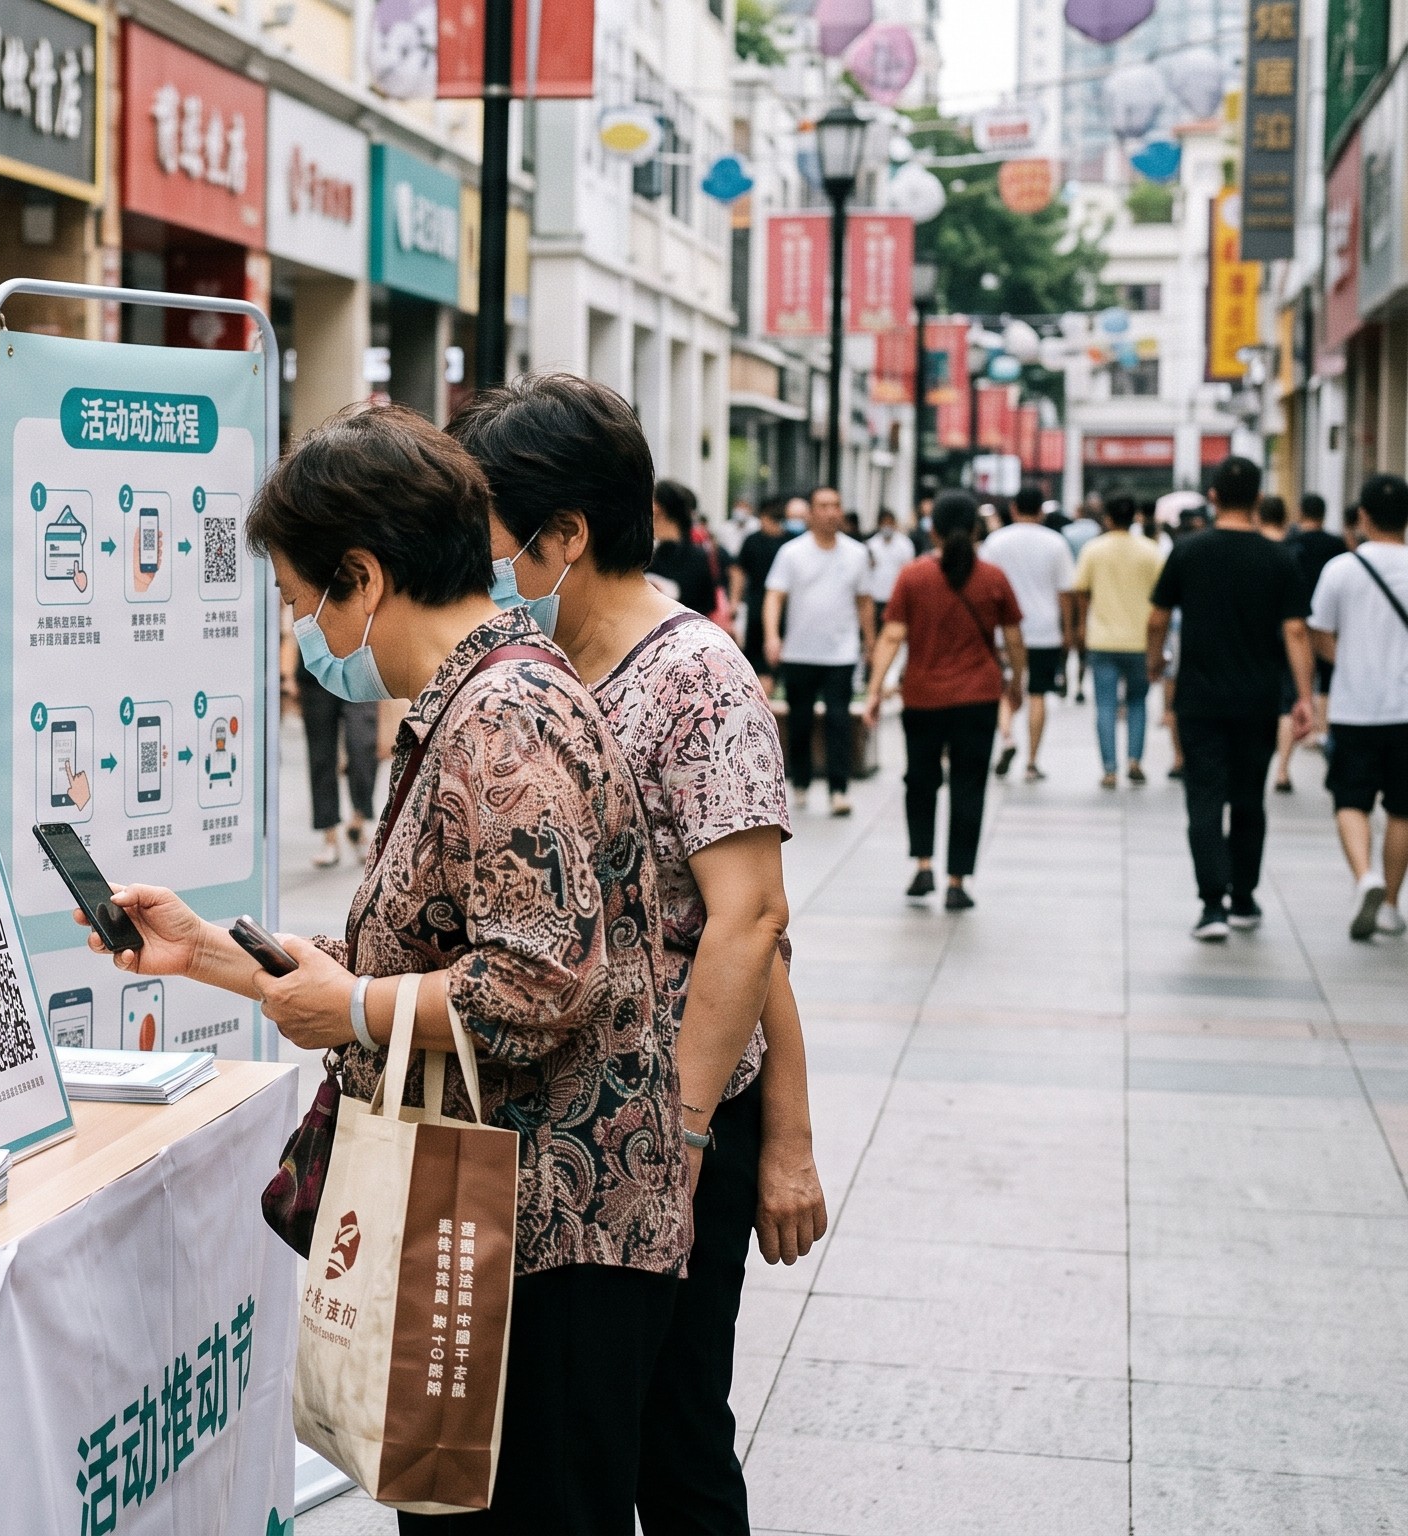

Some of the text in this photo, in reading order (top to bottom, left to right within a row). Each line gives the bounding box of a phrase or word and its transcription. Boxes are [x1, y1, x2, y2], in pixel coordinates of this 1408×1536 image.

[80, 396, 200, 445] 活动动流程
[35, 488, 42, 507] 1
[122, 490, 130, 508] 2
[195, 491, 203, 509] 3
[122, 702, 131, 720] 4
[196, 696, 204, 714] 5
[34, 709, 44, 726] 4
[75, 1293, 255, 1536] 活动推动节
